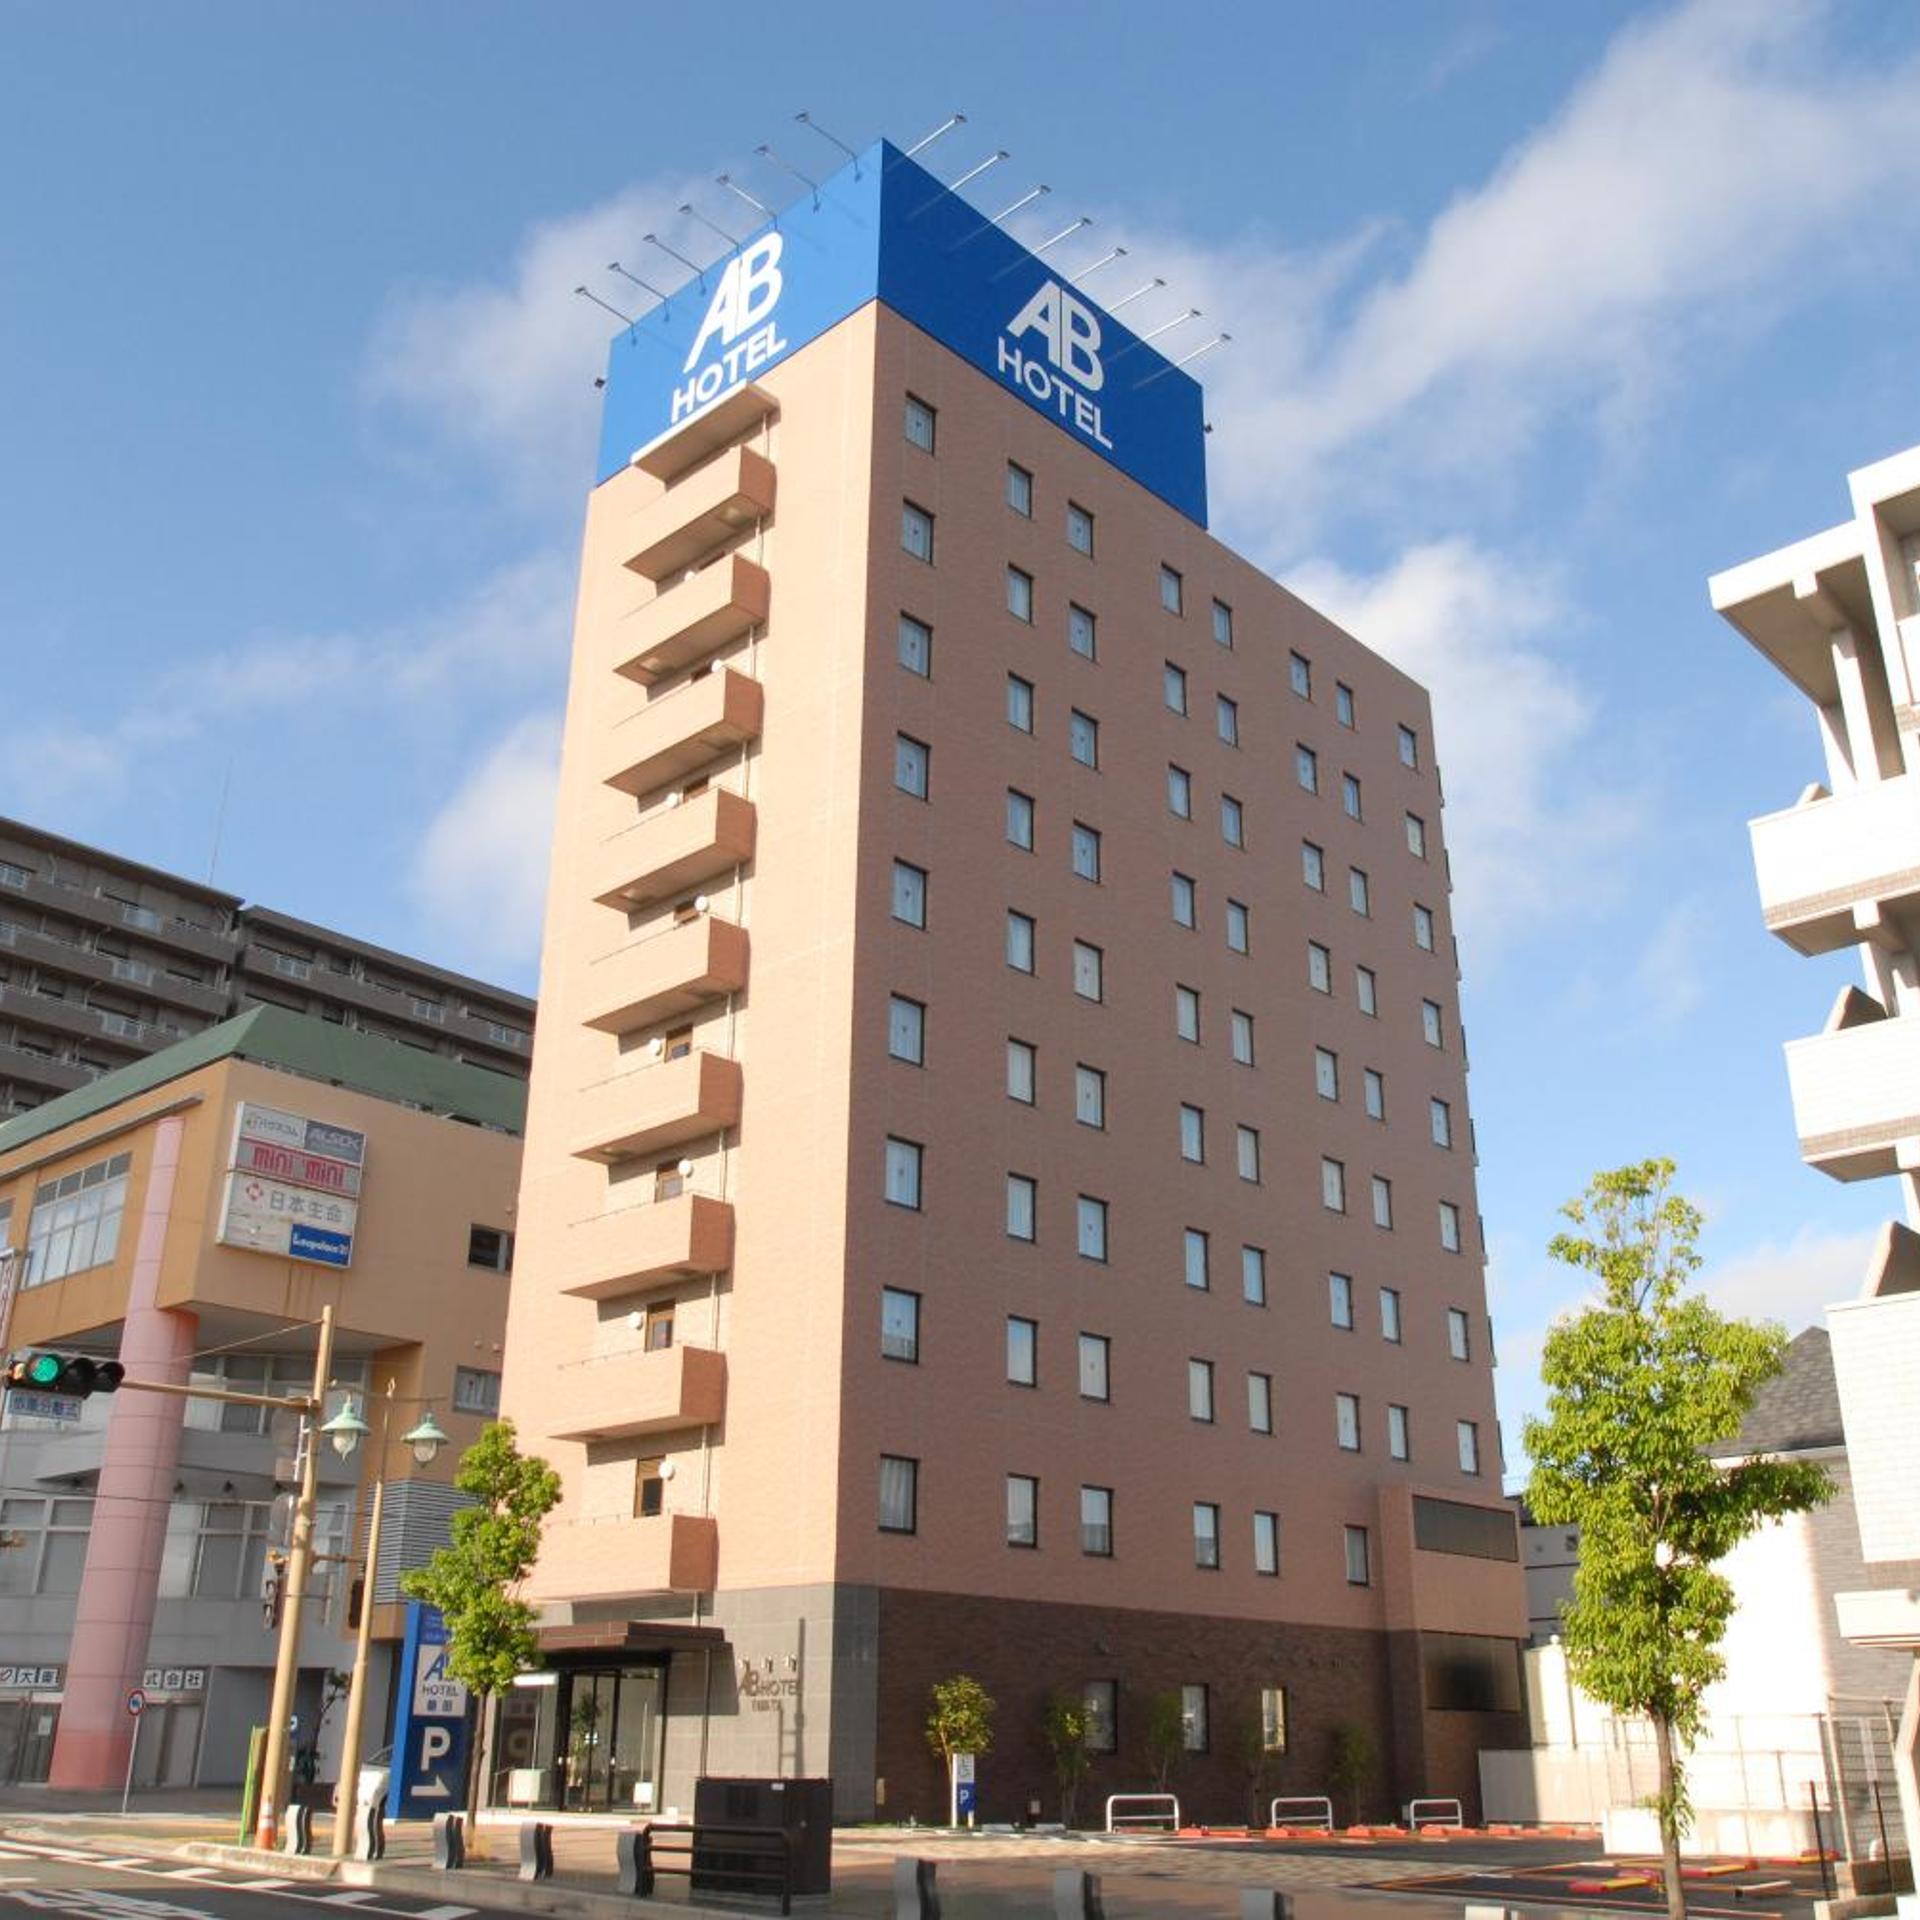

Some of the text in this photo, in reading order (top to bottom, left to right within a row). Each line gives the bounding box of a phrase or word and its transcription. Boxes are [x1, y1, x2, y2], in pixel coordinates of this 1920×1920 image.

[683, 232, 783, 373] AB
[1006, 280, 1104, 391] AB
[671, 321, 787, 423] HOTEL
[998, 336, 1113, 450] HOTEL
[253, 1146, 345, 1187] mini mini
[269, 1190, 344, 1222] 日本生命
[422, 1684, 459, 1697] HOTEL
[420, 1726, 451, 1772] P
[959, 1789, 969, 1805] P
